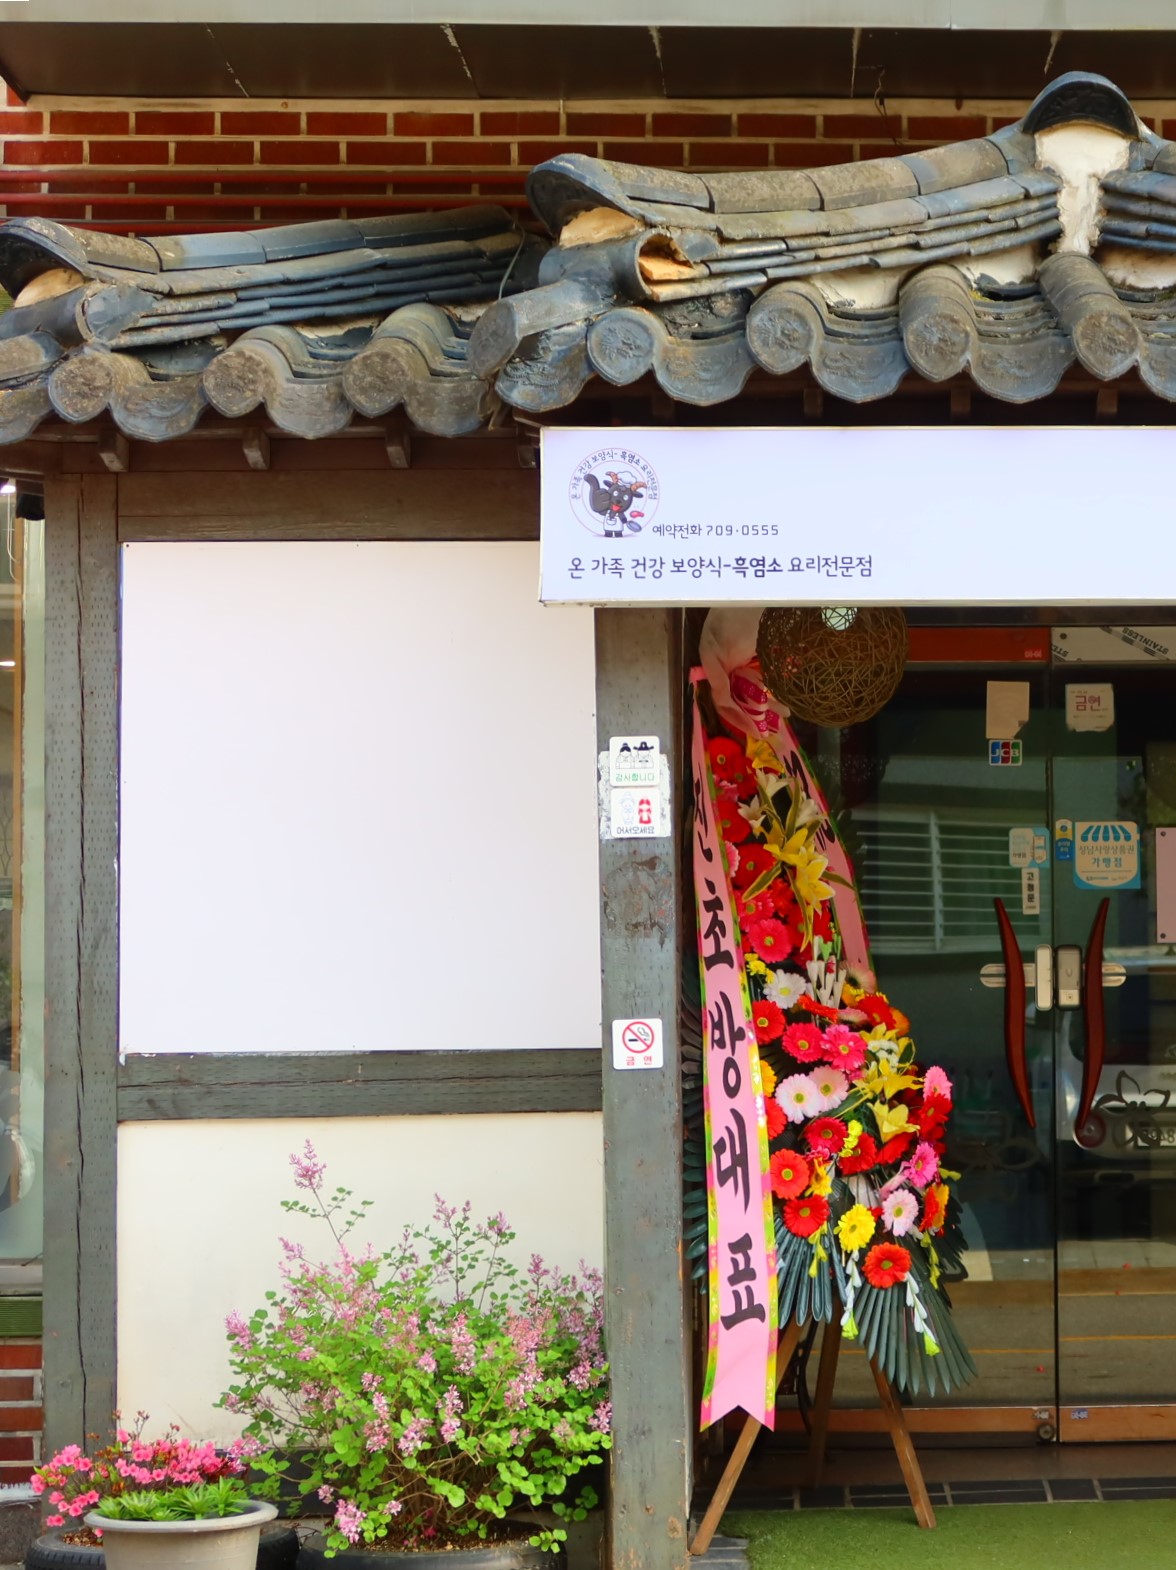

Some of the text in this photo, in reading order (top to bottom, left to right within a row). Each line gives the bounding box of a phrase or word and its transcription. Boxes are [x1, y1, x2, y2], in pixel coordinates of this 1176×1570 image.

[652, 523, 702, 539] 예약전화
[568, 557, 585, 579] 온
[591, 556, 625, 578] 가족
[631, 556, 666, 579] 건강
[787, 554, 873, 578] 요리전문점
[1122, 627, 1170, 655] STAINLESS
[1075, 695, 1101, 712] 금연
[991, 748, 1020, 757] JCB
[615, 773, 655, 782] 감사합니다
[616, 826, 655, 835] 어서오세요
